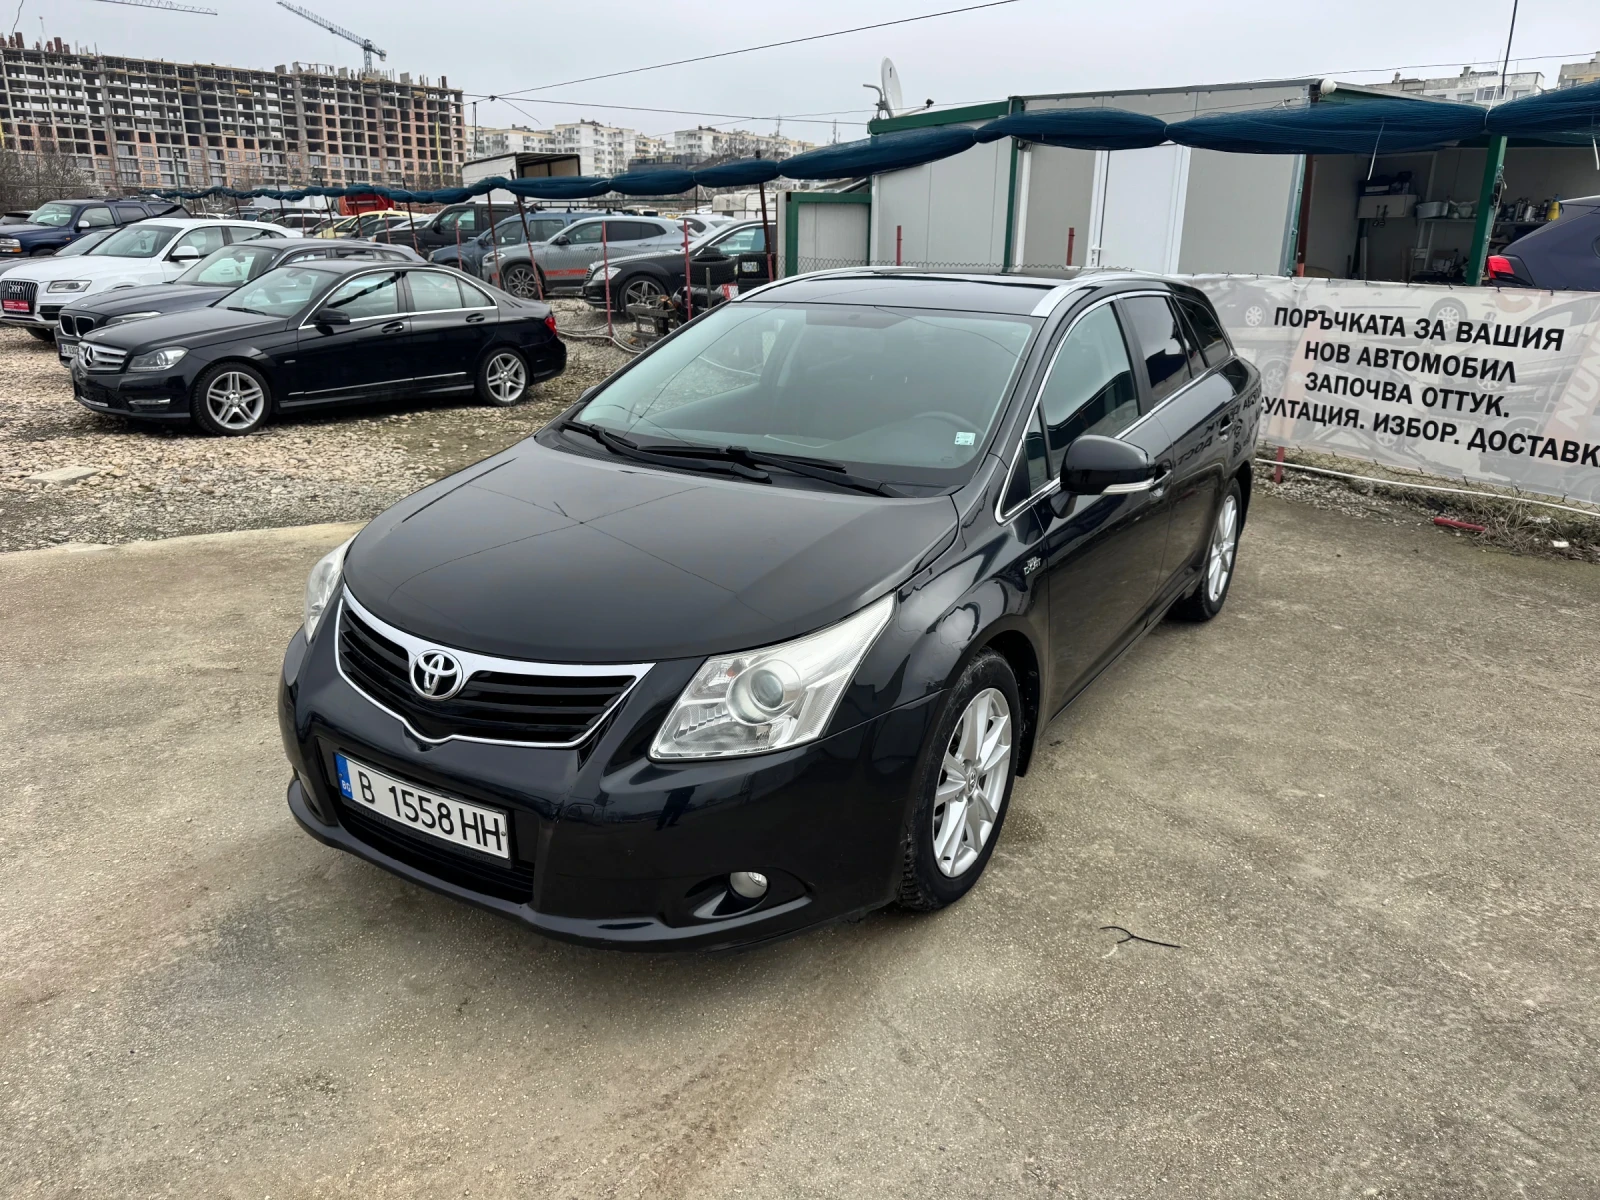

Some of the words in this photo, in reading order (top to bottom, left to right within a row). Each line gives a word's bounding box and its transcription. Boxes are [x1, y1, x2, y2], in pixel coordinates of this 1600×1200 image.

[1274, 306, 1406, 338] ПОРЪЧКАТА
[1413, 318, 1446, 341] ЗА
[1456, 321, 1565, 352] ВАШИЯ
[1304, 340, 1351, 364] НОВ
[1356, 346, 1516, 384] АВТОМОБИЛ
[1304, 371, 1413, 405] ЗАПОЧВА
[1421, 386, 1510, 418] ОТТУК.
[1372, 412, 1460, 445] ИЗБОР.
[1466, 427, 1600, 468] ДОСТАВК
[357, 770, 376, 804] B
[388, 786, 455, 836] 1558
[459, 807, 502, 852] HH
